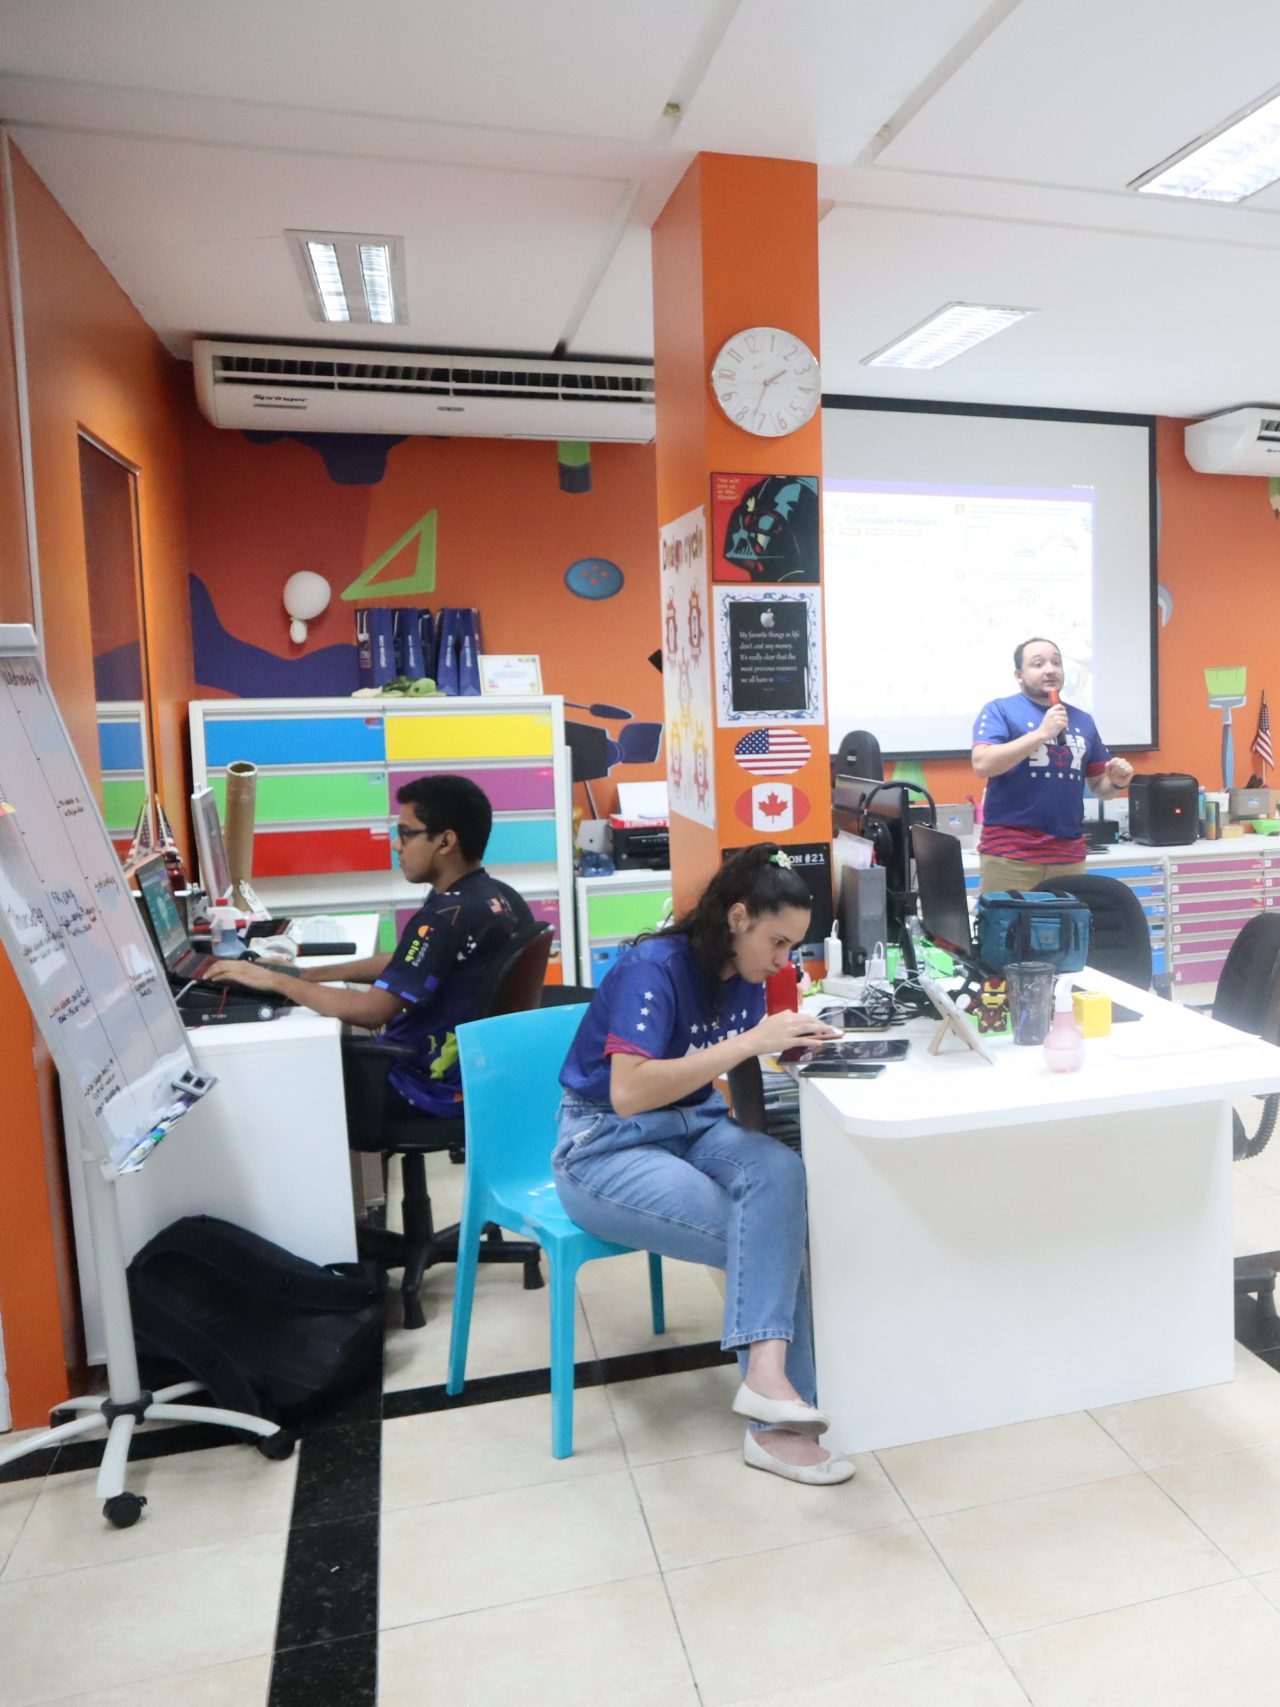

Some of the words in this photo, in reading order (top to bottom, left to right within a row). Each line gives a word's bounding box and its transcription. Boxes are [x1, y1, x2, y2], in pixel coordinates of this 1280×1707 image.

[782, 344, 799, 362] 2
[716, 367, 737, 381] 10
[793, 363, 813, 376] 3
[720, 390, 738, 402] 9
[796, 385, 816, 395] 4
[735, 405, 750, 422] 8
[788, 400, 806, 418] 5
[757, 412, 767, 431] 7
[776, 410, 789, 431] 6
[739, 631, 747, 640] My
[804, 853, 825, 863] #21
[405, 940, 420, 963] club
[412, 942, 429, 967] coding
